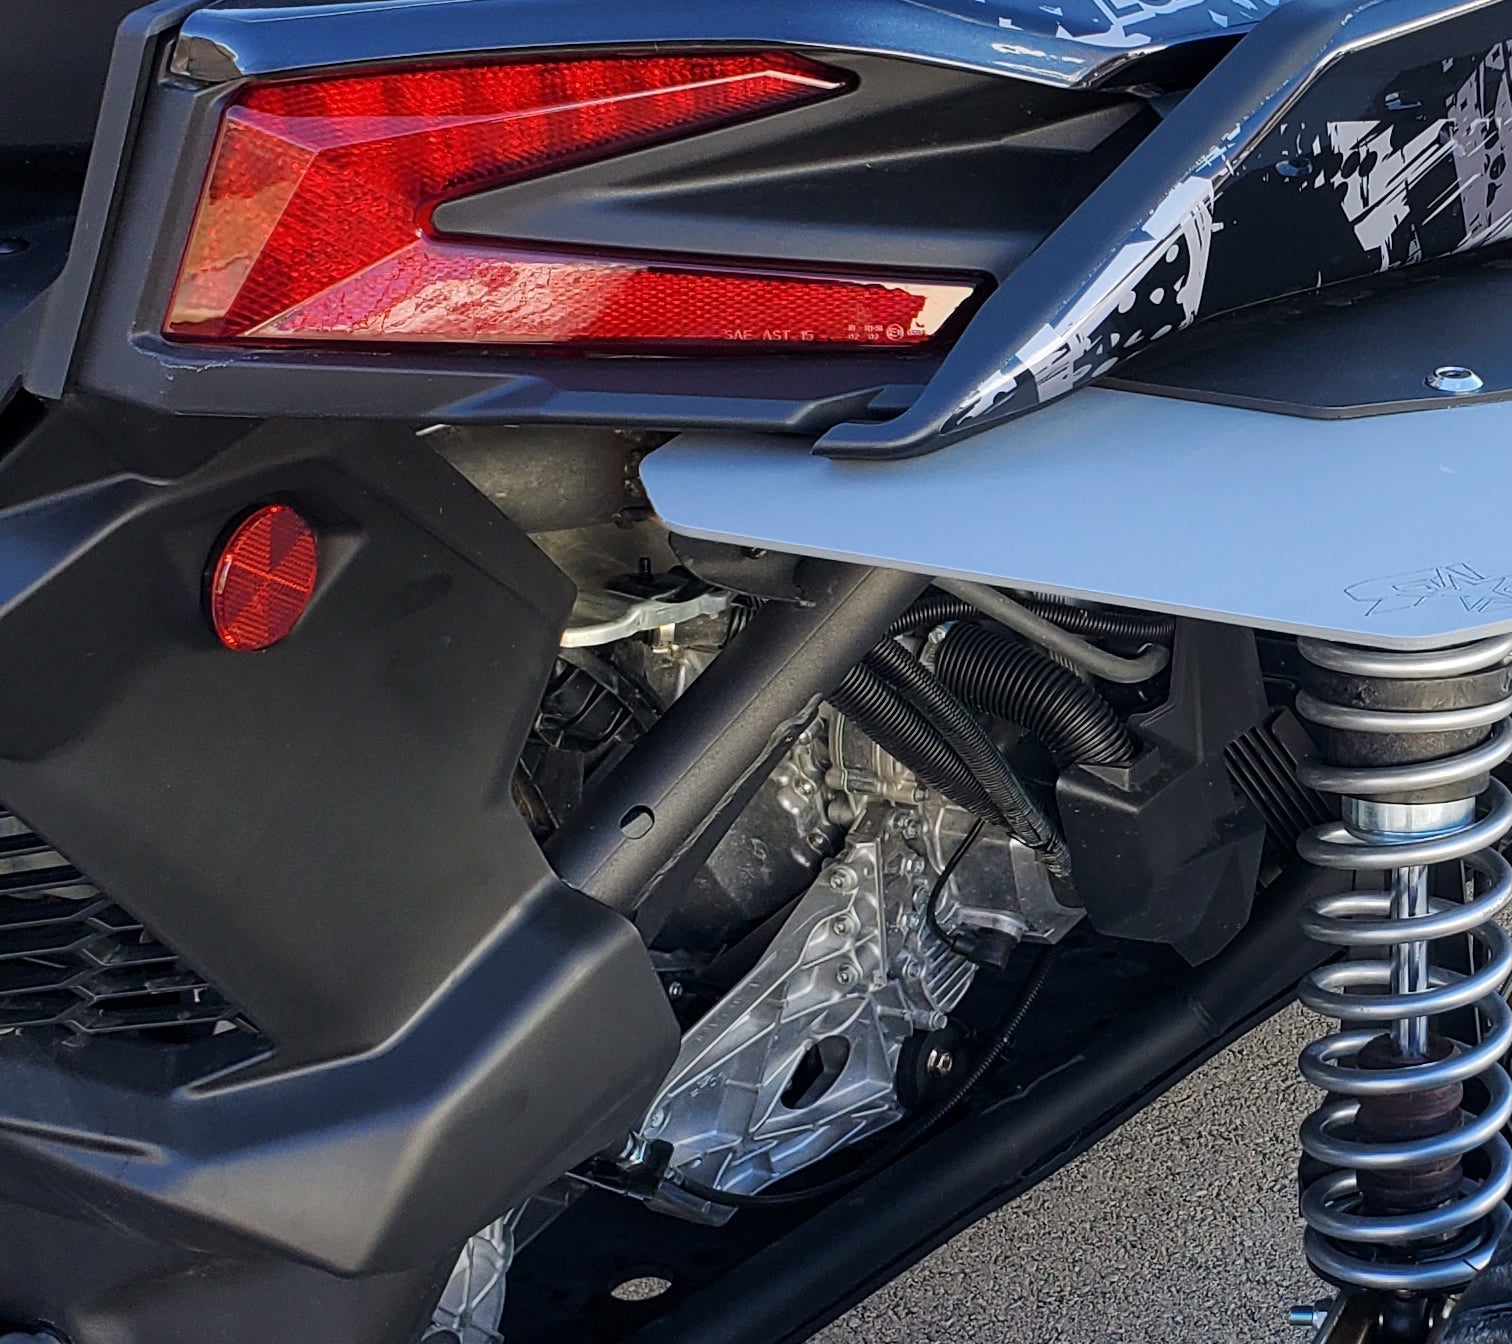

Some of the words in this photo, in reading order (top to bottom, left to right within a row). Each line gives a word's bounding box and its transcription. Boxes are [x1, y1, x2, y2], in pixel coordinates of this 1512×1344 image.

[724, 329, 753, 341] SAE
[762, 329, 791, 341] AST
[800, 329, 815, 341] 15
